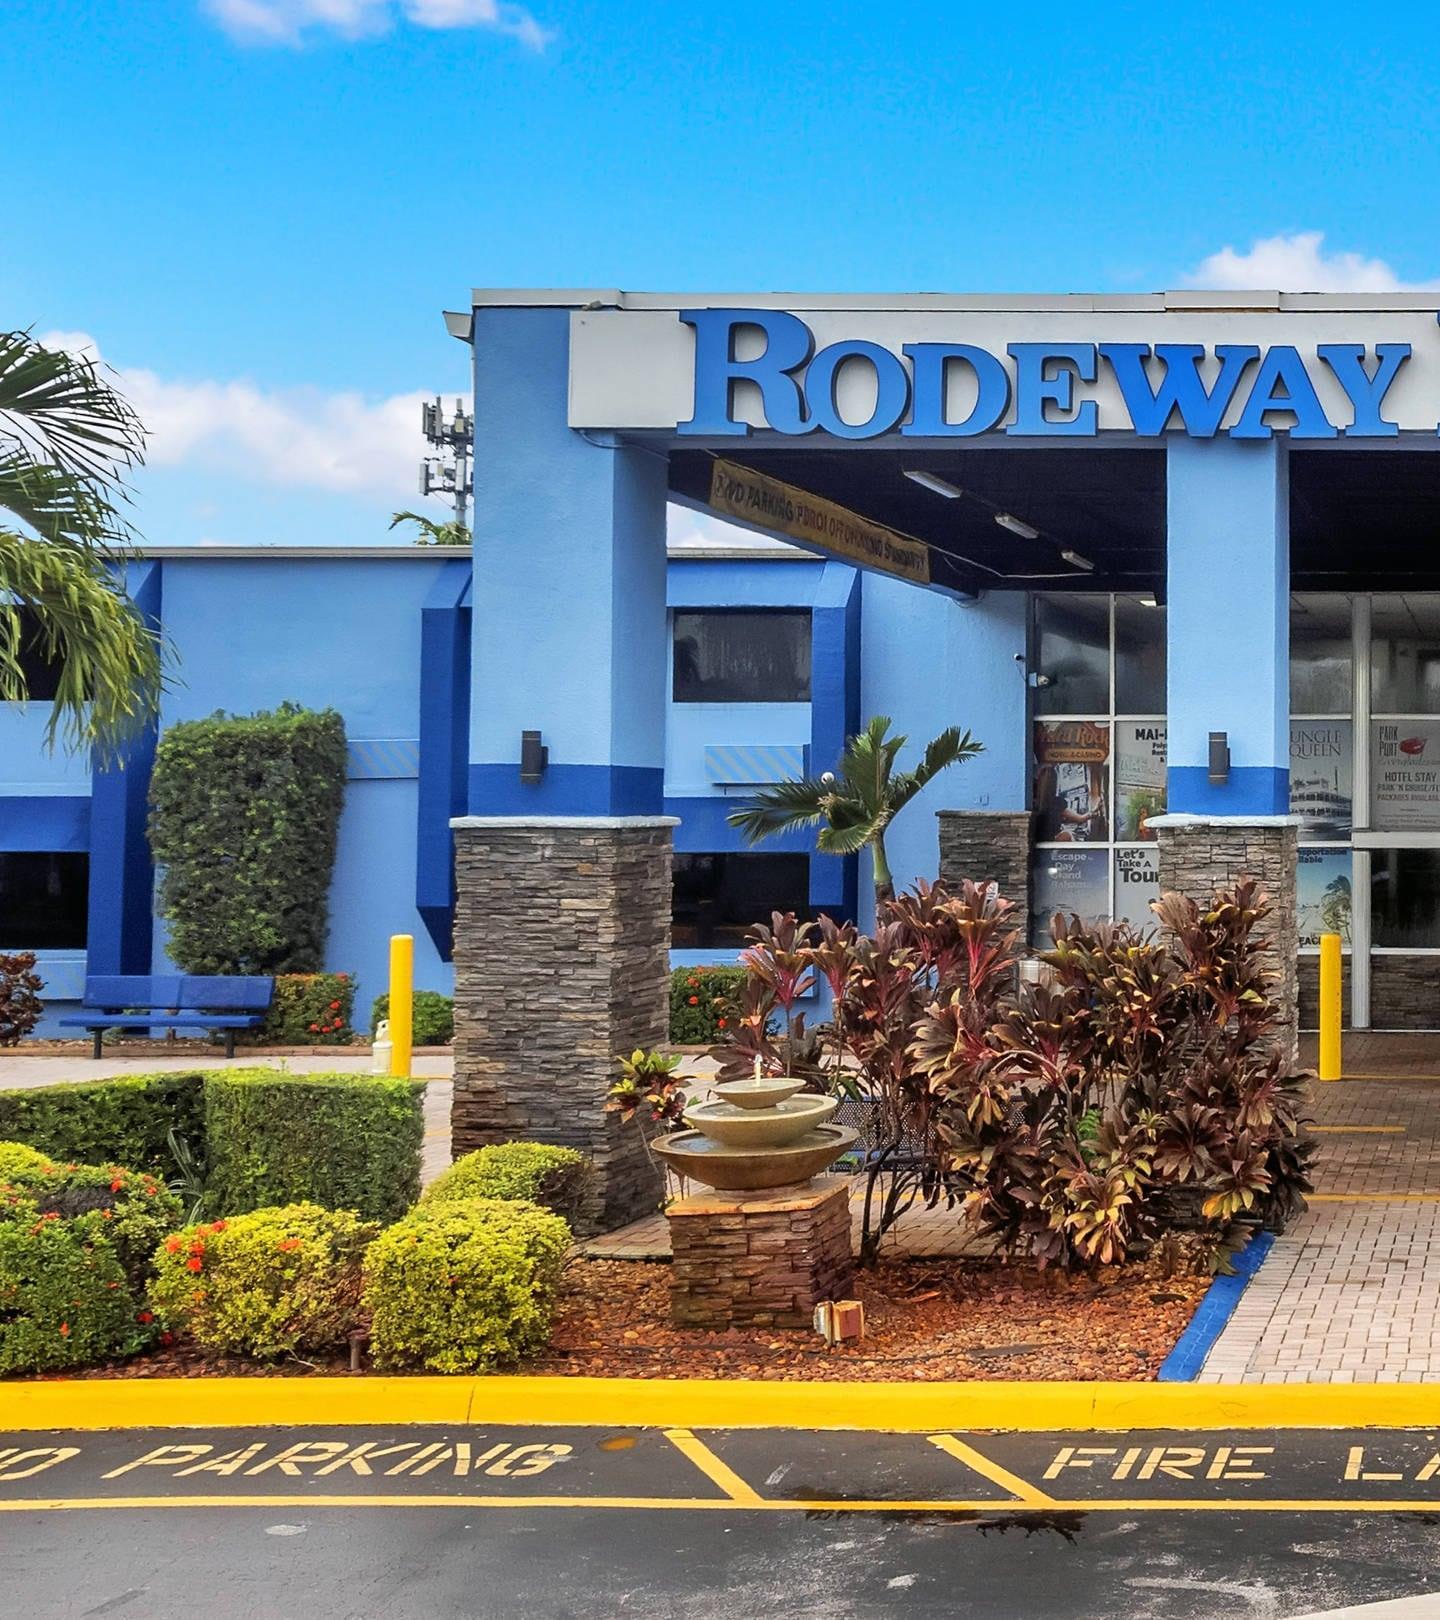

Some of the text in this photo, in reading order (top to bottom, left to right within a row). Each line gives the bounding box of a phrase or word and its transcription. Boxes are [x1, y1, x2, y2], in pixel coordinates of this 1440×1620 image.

[676, 308, 1412, 439] RODEWAY
[1135, 728, 1167, 740] MAI-
[1290, 730, 1341, 744] UNGLE
[1289, 743, 1341, 759] QUEEN
[1384, 771, 1437, 782] HOTEL STAY
[1051, 853, 1087, 861] Escape
[1116, 848, 1145, 859] Let's
[1118, 860, 1142, 868] Take
[1299, 936, 1321, 945] EAC
[104, 1441, 573, 1479] PARKING
[1042, 1447, 1275, 1480] FIRE
